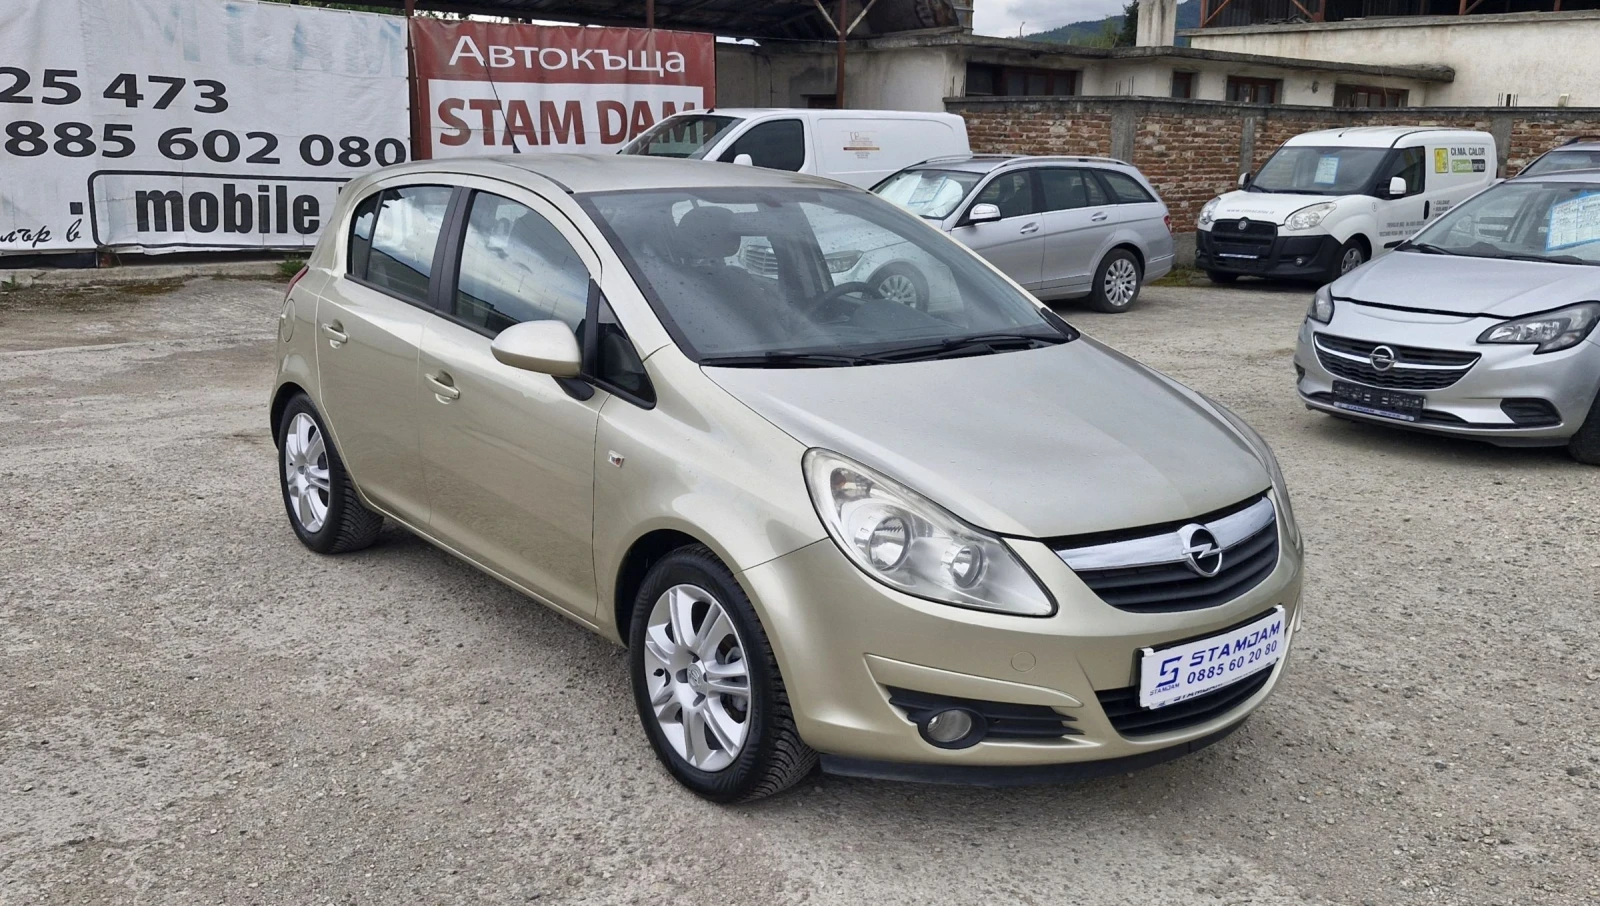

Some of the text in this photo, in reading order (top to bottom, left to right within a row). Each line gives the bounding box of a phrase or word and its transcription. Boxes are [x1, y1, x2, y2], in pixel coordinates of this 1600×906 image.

[449, 35, 686, 77] Автокъща
[103, 73, 229, 114] 473
[4, 120, 407, 167] 885 602 080
[438, 97, 698, 146] STAM DAM
[135, 183, 320, 235] mobile
[1187, 663, 1225, 685] 0885
[1228, 655, 1245, 672] 60
[1248, 647, 1262, 664] 20
[1264, 640, 1278, 656] 80
